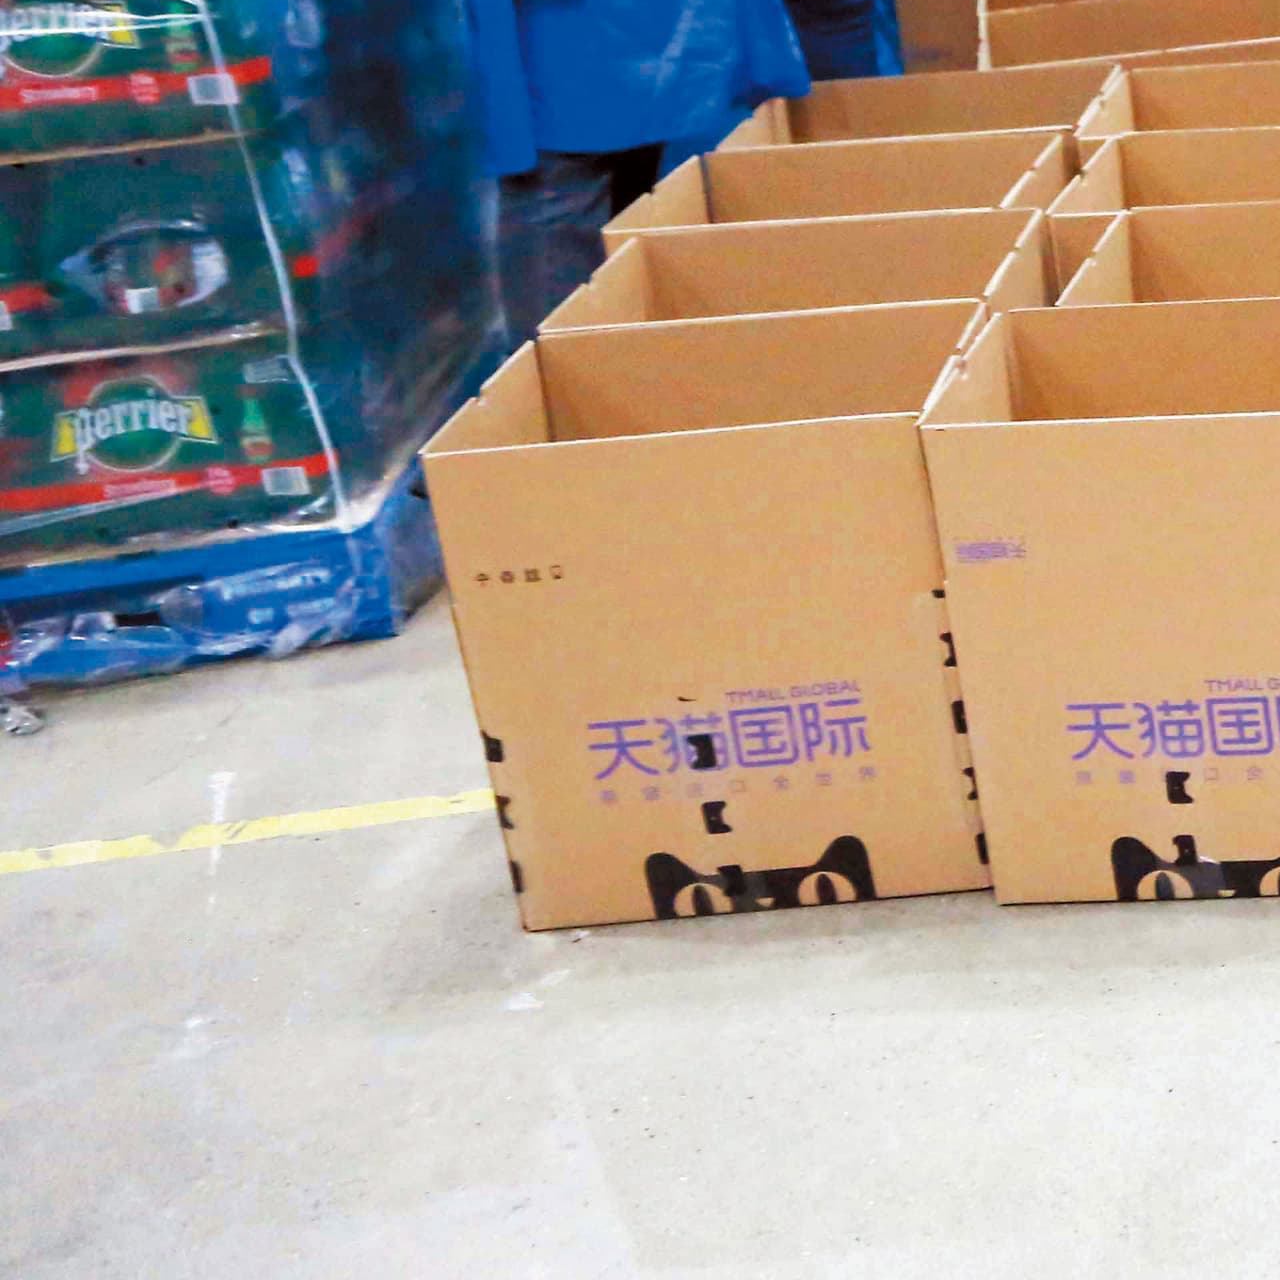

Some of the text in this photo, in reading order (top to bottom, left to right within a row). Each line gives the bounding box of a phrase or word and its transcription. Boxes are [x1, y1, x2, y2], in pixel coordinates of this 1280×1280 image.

[724, 679, 862, 704] TMALL GLOBAL
[1203, 677, 1264, 693] TMALL
[587, 698, 871, 780] 天猫国际
